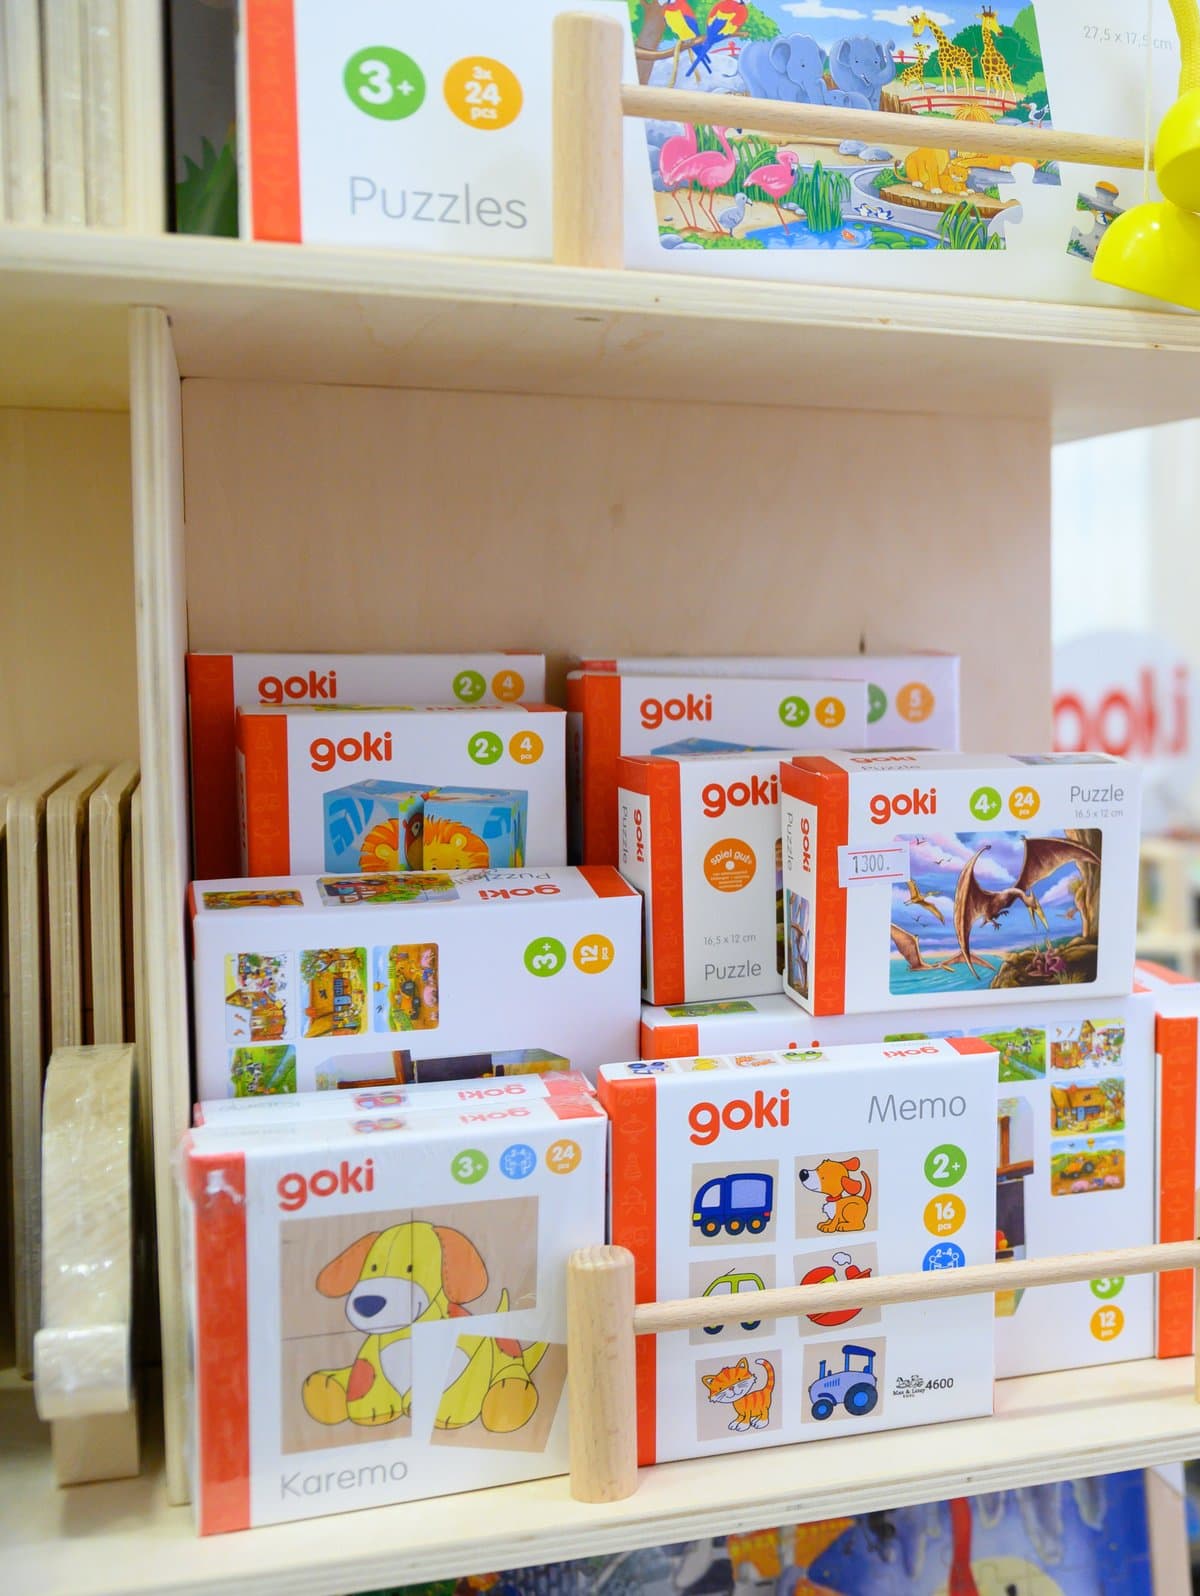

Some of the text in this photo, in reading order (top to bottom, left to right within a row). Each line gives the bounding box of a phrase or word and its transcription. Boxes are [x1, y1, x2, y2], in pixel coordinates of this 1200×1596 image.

[1114, 32, 1121, 42] x
[358, 59, 415, 105] 3+
[464, 80, 502, 106] 24
[470, 107, 497, 120] pcs
[349, 175, 528, 230] Puzzles
[258, 670, 337, 704] goki
[502, 675, 514, 689] 4
[639, 693, 713, 729] goki
[824, 702, 836, 716] 4
[309, 731, 393, 773] goki
[475, 737, 498, 759] 2+
[520, 736, 533, 752] 4
[702, 774, 778, 818] goki
[974, 793, 998, 814] 4+
[1014, 791, 1035, 808] 24
[1070, 783, 1125, 804] Puzzle
[870, 787, 938, 826] goki
[633, 808, 645, 863] goki
[800, 817, 812, 873] goki
[478, 884, 561, 901] goki
[742, 934, 756, 944] cm
[532, 943, 558, 970] 3+
[580, 944, 598, 965] 12
[704, 959, 762, 981] Puzzle
[882, 1046, 939, 1059] goki
[457, 1083, 527, 1101] goki
[688, 1088, 967, 1146] goki Memo
[551, 1144, 576, 1162] 24
[932, 1153, 961, 1179] 2+
[277, 1157, 375, 1212] goki
[935, 1201, 956, 1221] 16
[1099, 1311, 1117, 1328] 12
[925, 1377, 954, 1391] 4600
[280, 1459, 408, 1501] Karemo
